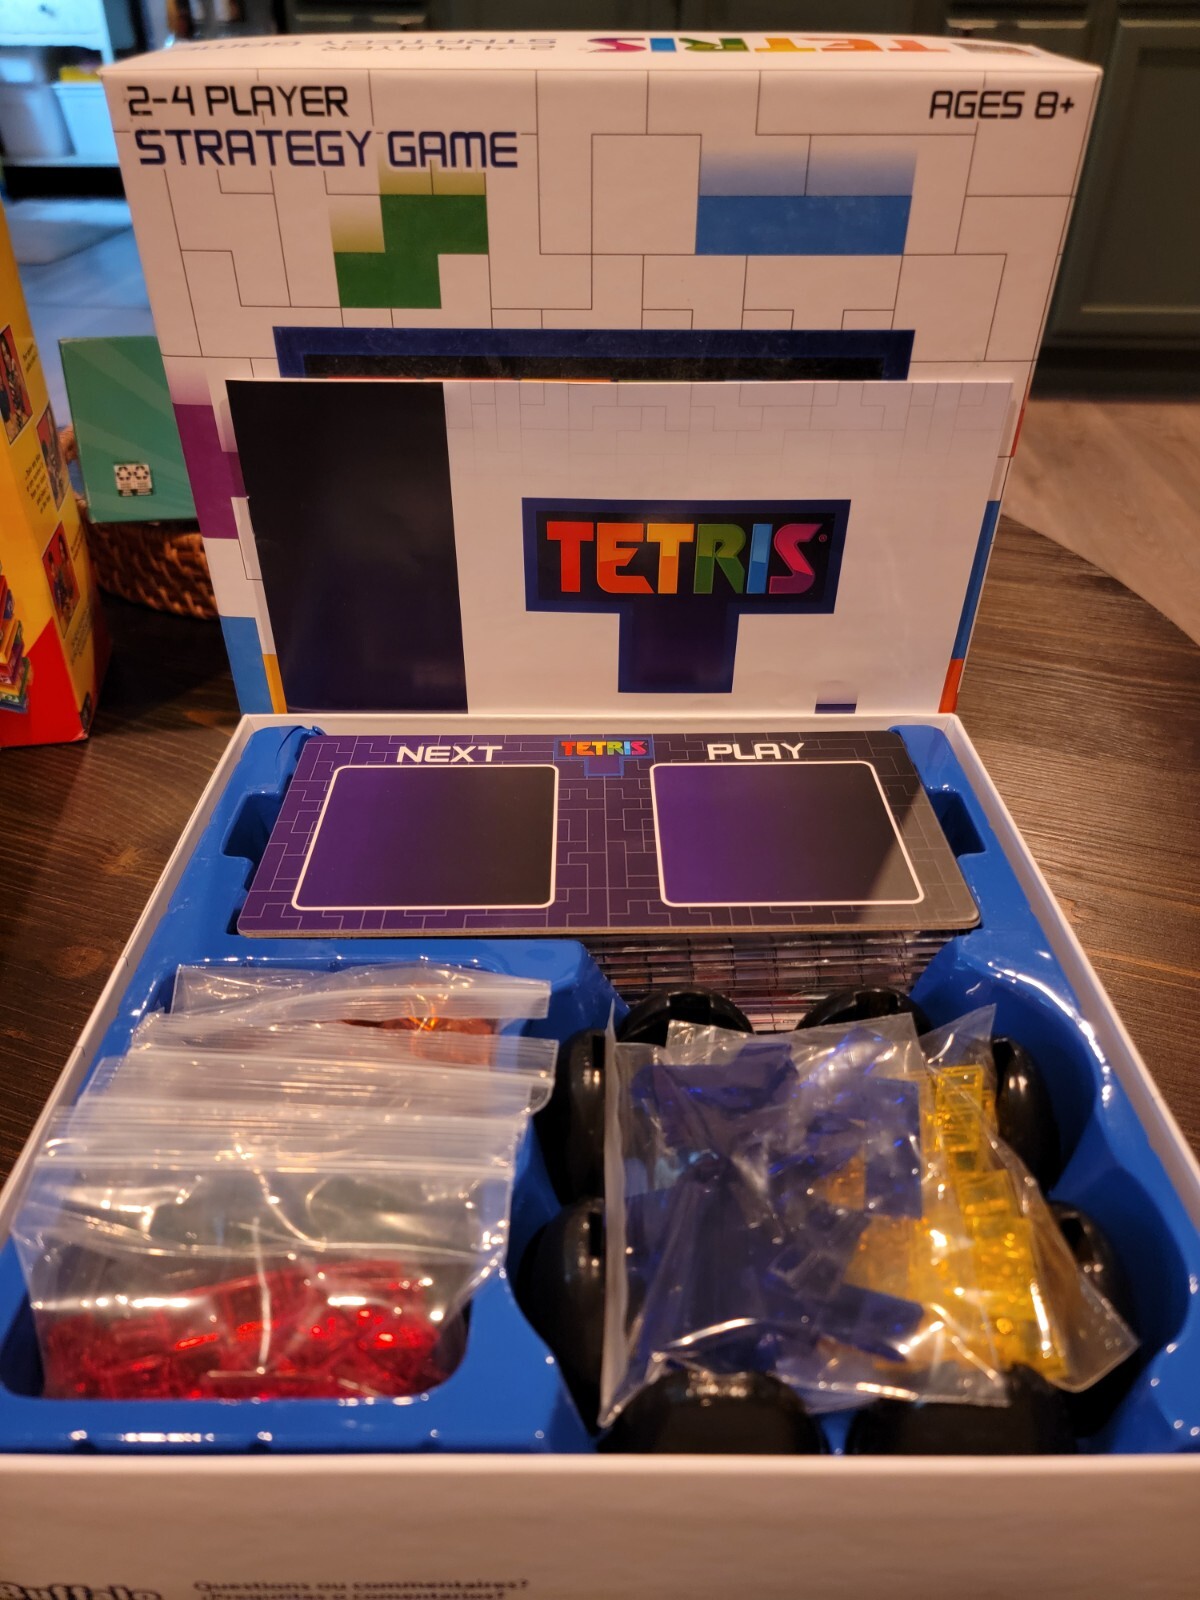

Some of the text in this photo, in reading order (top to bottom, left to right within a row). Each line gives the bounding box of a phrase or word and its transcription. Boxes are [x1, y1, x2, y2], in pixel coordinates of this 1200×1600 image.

[587, 38, 951, 52] TETRIS
[127, 86, 349, 117] 2-4 PLAYER
[929, 90, 1075, 119] AGES 8+
[135, 129, 518, 168] STRATEGY GAME
[396, 745, 503, 763] NEXT
[561, 741, 647, 756] TETRIS
[707, 742, 805, 761] PLAY
